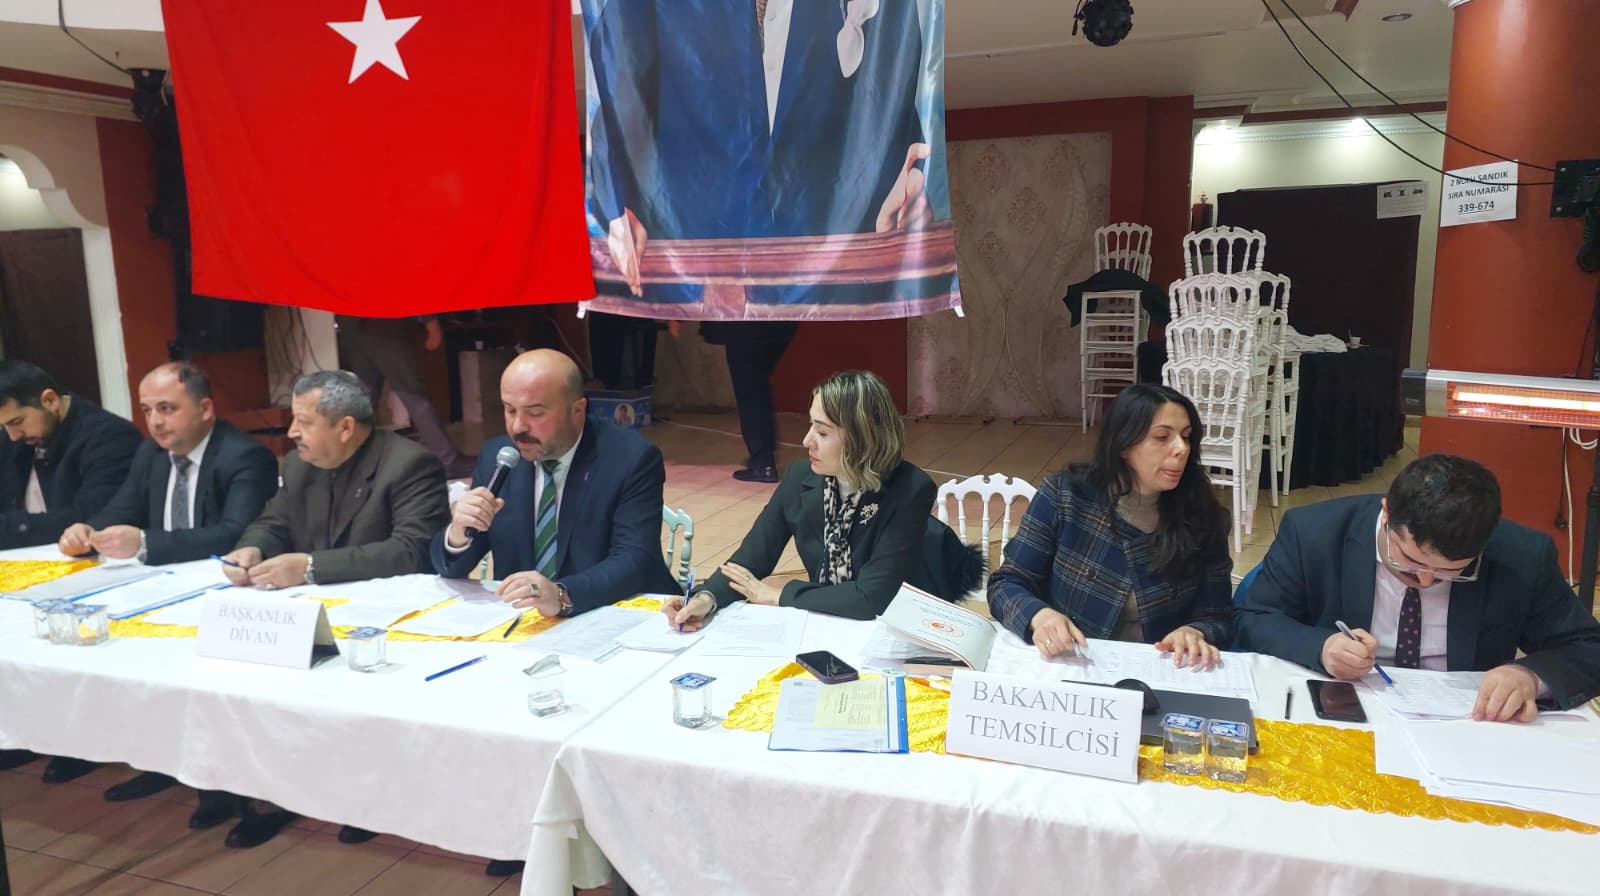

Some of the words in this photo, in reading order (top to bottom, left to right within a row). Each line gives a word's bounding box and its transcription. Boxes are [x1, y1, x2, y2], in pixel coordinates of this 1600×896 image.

[1450, 179, 1455, 187] 2
[1477, 170, 1509, 182] SANDIK
[1465, 185, 1509, 197] NUMARASI
[1458, 201, 1495, 214] 339-674
[218, 604, 297, 625] BAŞKANLIK
[229, 626, 279, 646] DİVANI
[972, 680, 1120, 721] BAKANLIK
[965, 713, 1121, 758] TEMSİLCİSİ
